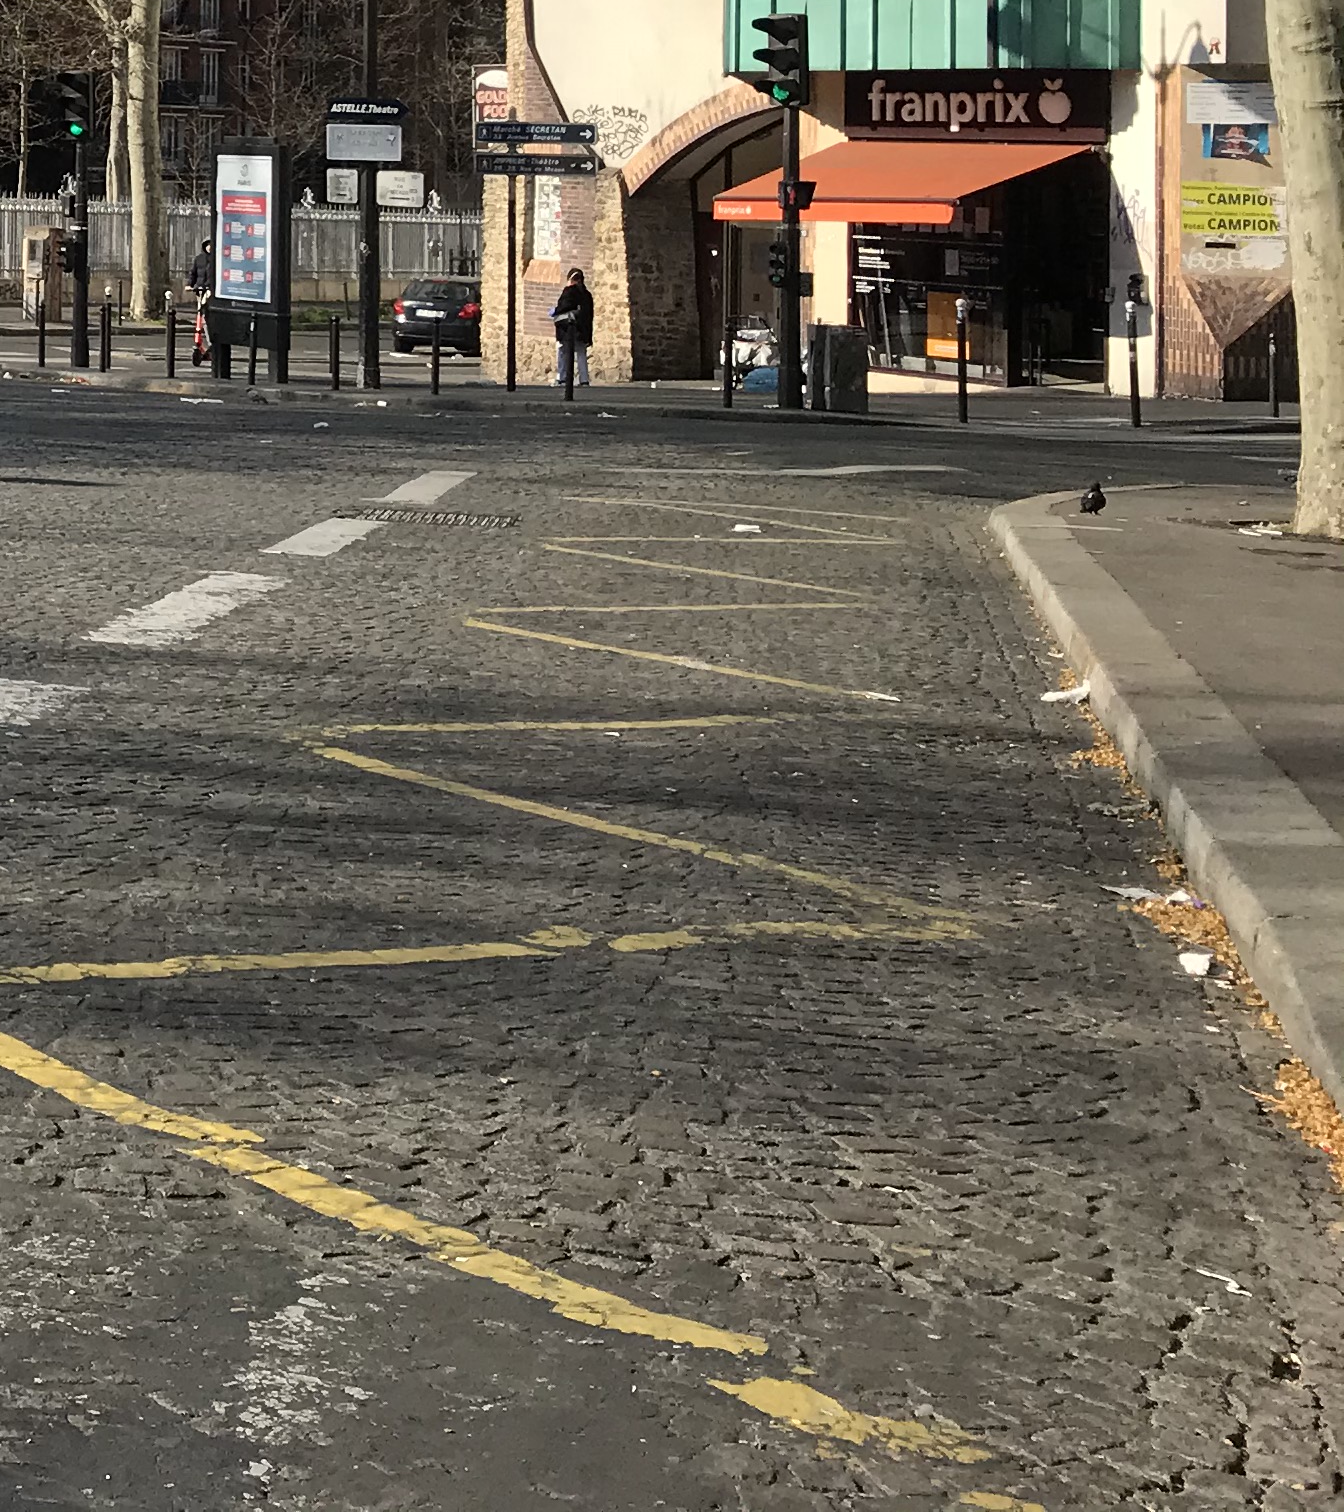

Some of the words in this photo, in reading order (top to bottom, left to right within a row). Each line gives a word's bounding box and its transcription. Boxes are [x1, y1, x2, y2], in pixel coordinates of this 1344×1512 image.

[476, 90, 508, 104] GOLD
[483, 105, 508, 117] FOO
[868, 77, 1031, 132] franprix
[1207, 218, 1280, 232] CAMPION
